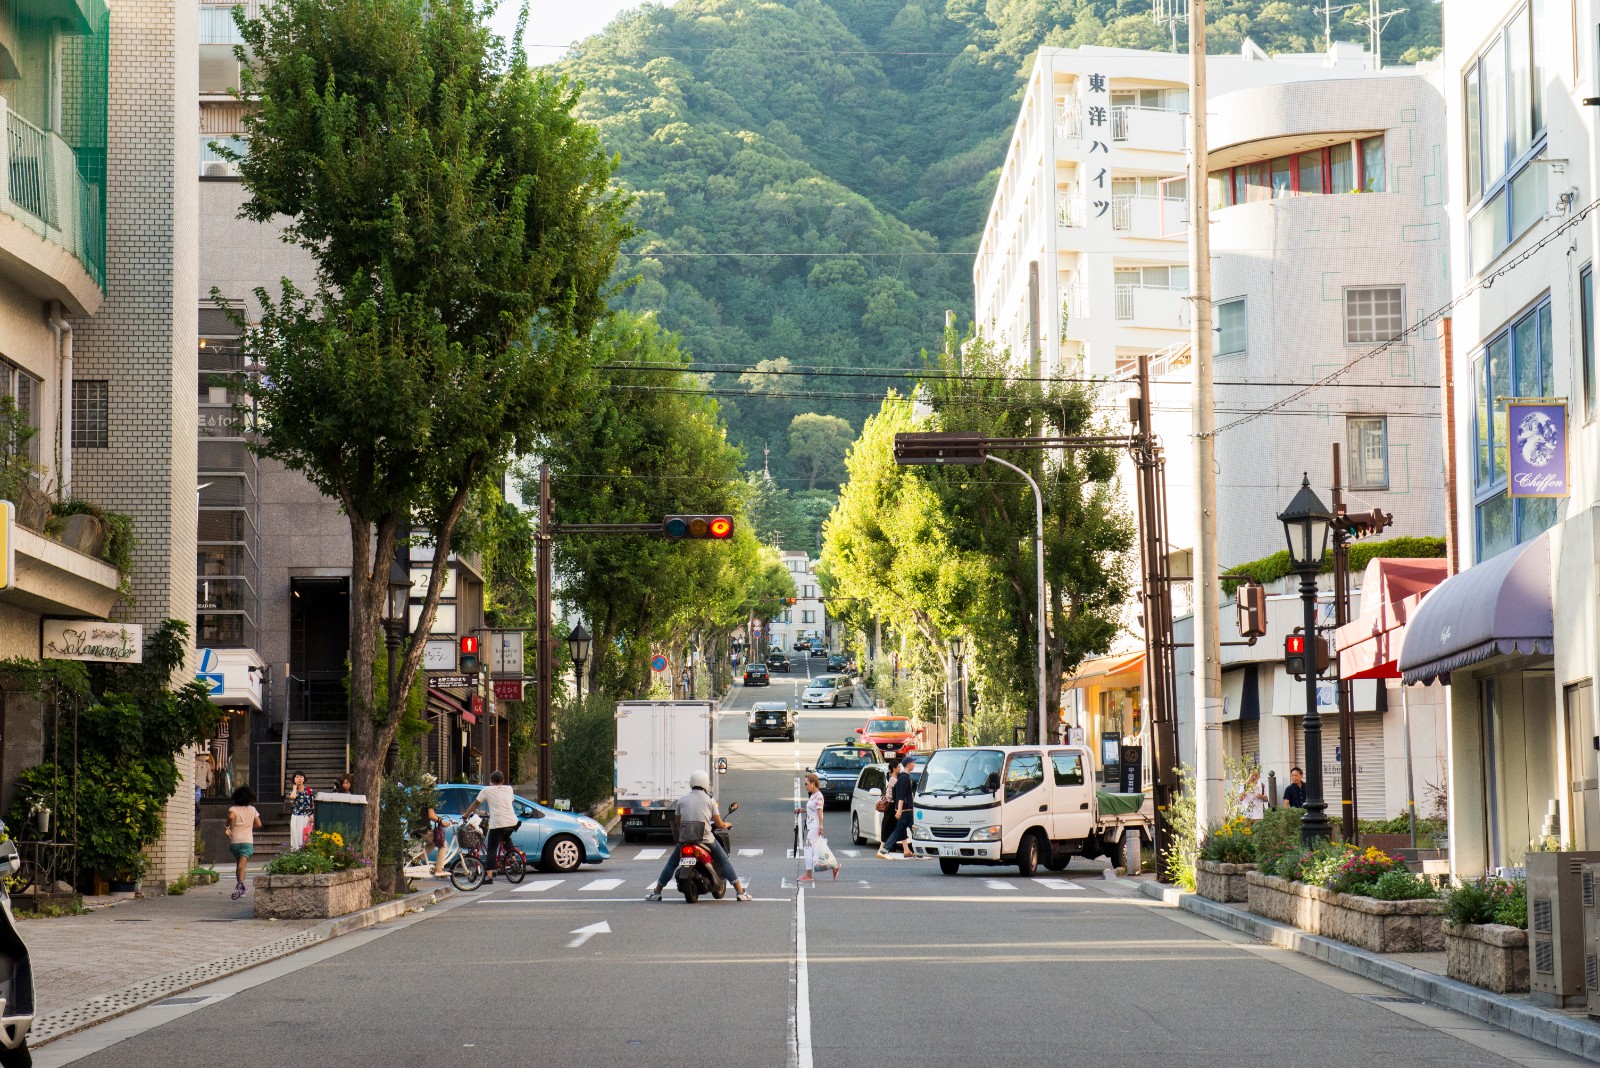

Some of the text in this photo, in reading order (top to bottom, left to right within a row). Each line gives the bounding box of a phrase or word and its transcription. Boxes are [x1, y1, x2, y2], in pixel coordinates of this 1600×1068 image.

[1087, 73, 1110, 219] 東洋ハイツ
[1514, 472, 1563, 493] Chiffon
[202, 581, 209, 601] 1
